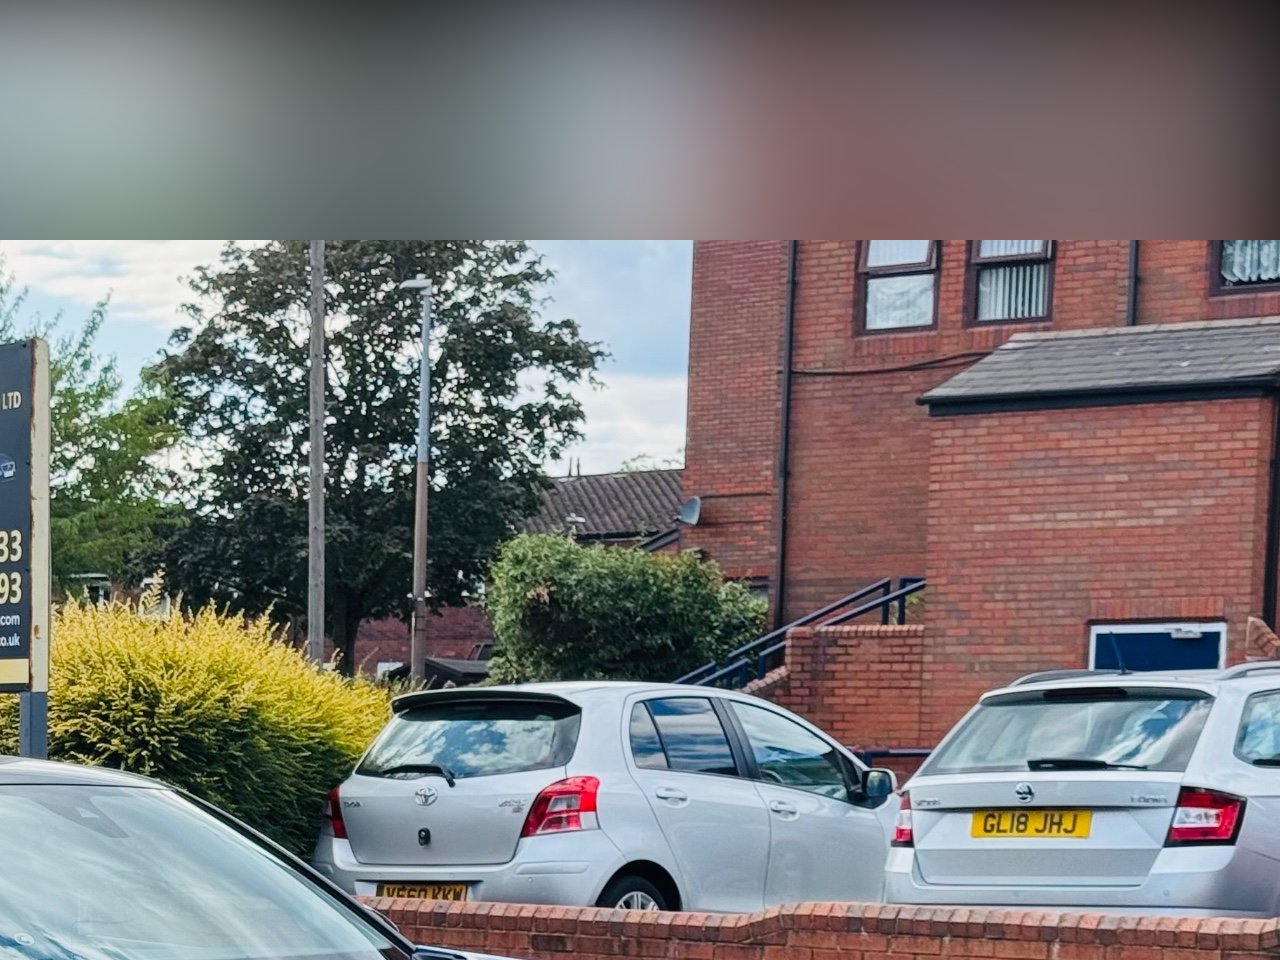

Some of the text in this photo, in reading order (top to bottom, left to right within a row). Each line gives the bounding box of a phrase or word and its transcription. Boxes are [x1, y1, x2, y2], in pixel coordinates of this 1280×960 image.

[2, 391, 22, 410] LTD
[983, 813, 1078, 834] GL18 JHJ
